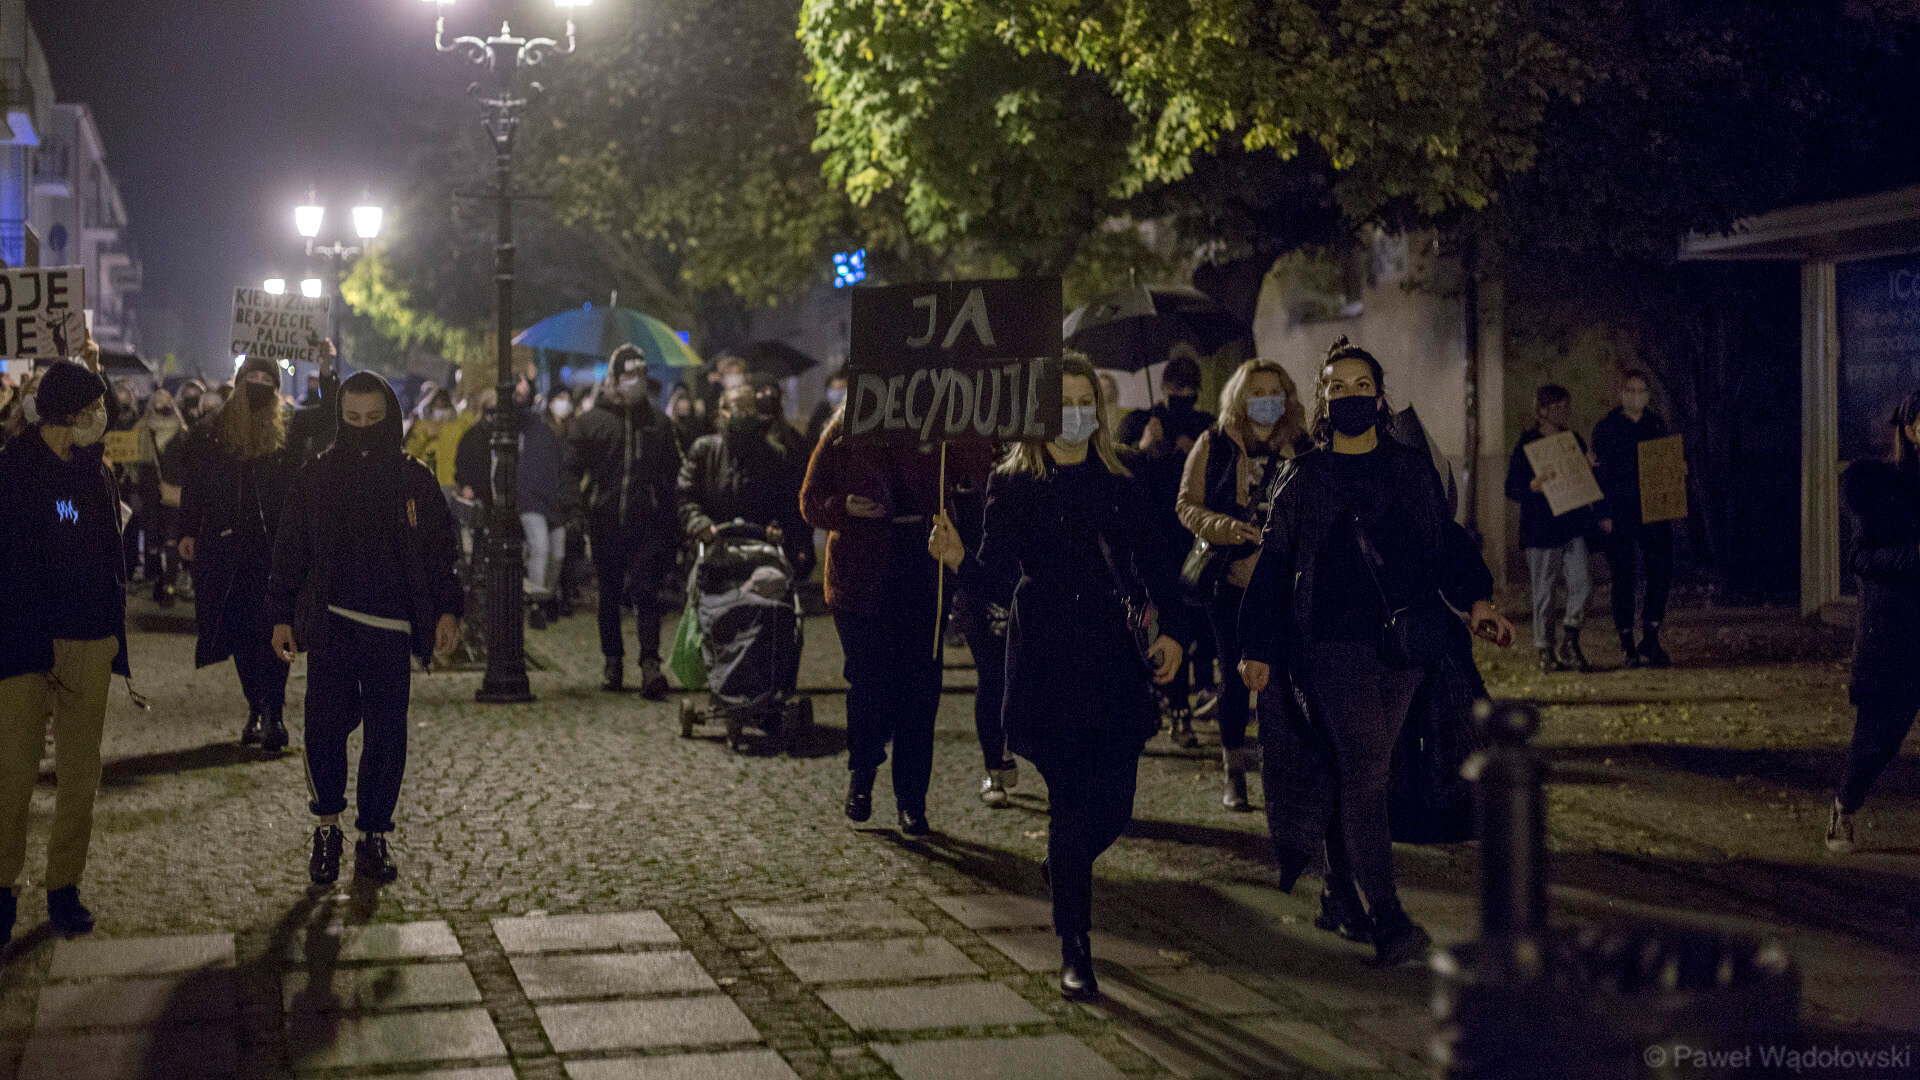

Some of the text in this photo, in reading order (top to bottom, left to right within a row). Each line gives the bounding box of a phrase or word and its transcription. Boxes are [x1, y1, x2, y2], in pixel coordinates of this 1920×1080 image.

[235, 307, 315, 331] BĘDZIECIE
[906, 287, 996, 348] JA
[851, 357, 1046, 441] DECYDUJE
